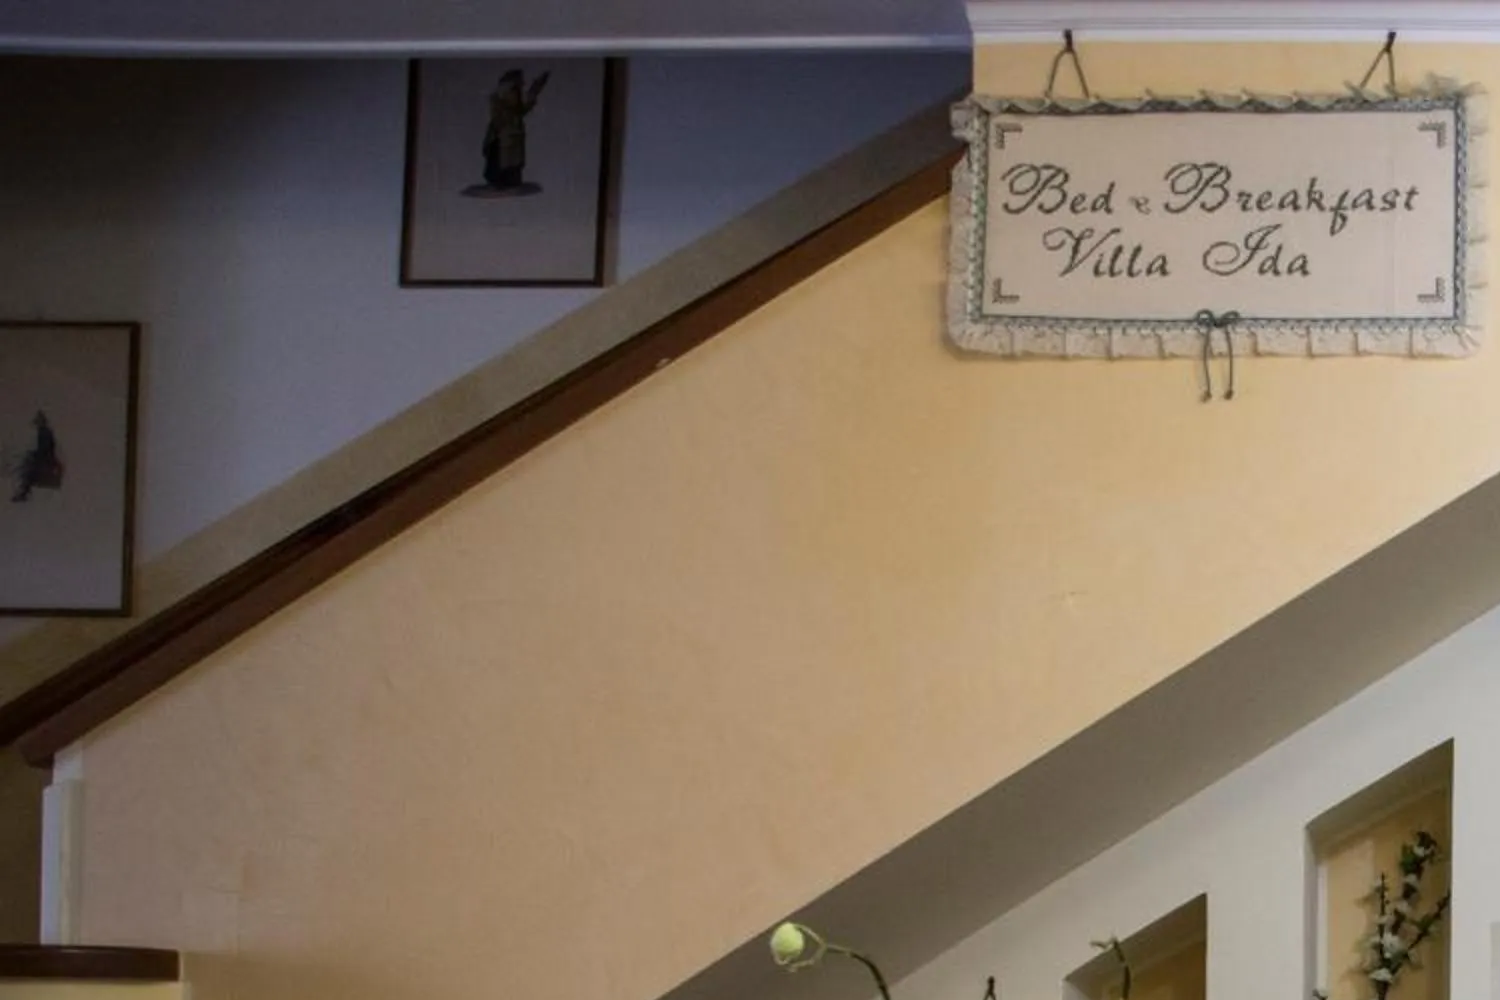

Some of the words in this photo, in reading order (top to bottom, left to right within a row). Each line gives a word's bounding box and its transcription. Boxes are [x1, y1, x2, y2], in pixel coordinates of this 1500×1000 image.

[1001, 163, 1114, 215] Bed
[1164, 163, 1420, 234] Breakfast
[1042, 227, 1170, 279] Villa
[1202, 224, 1311, 278] Ida
